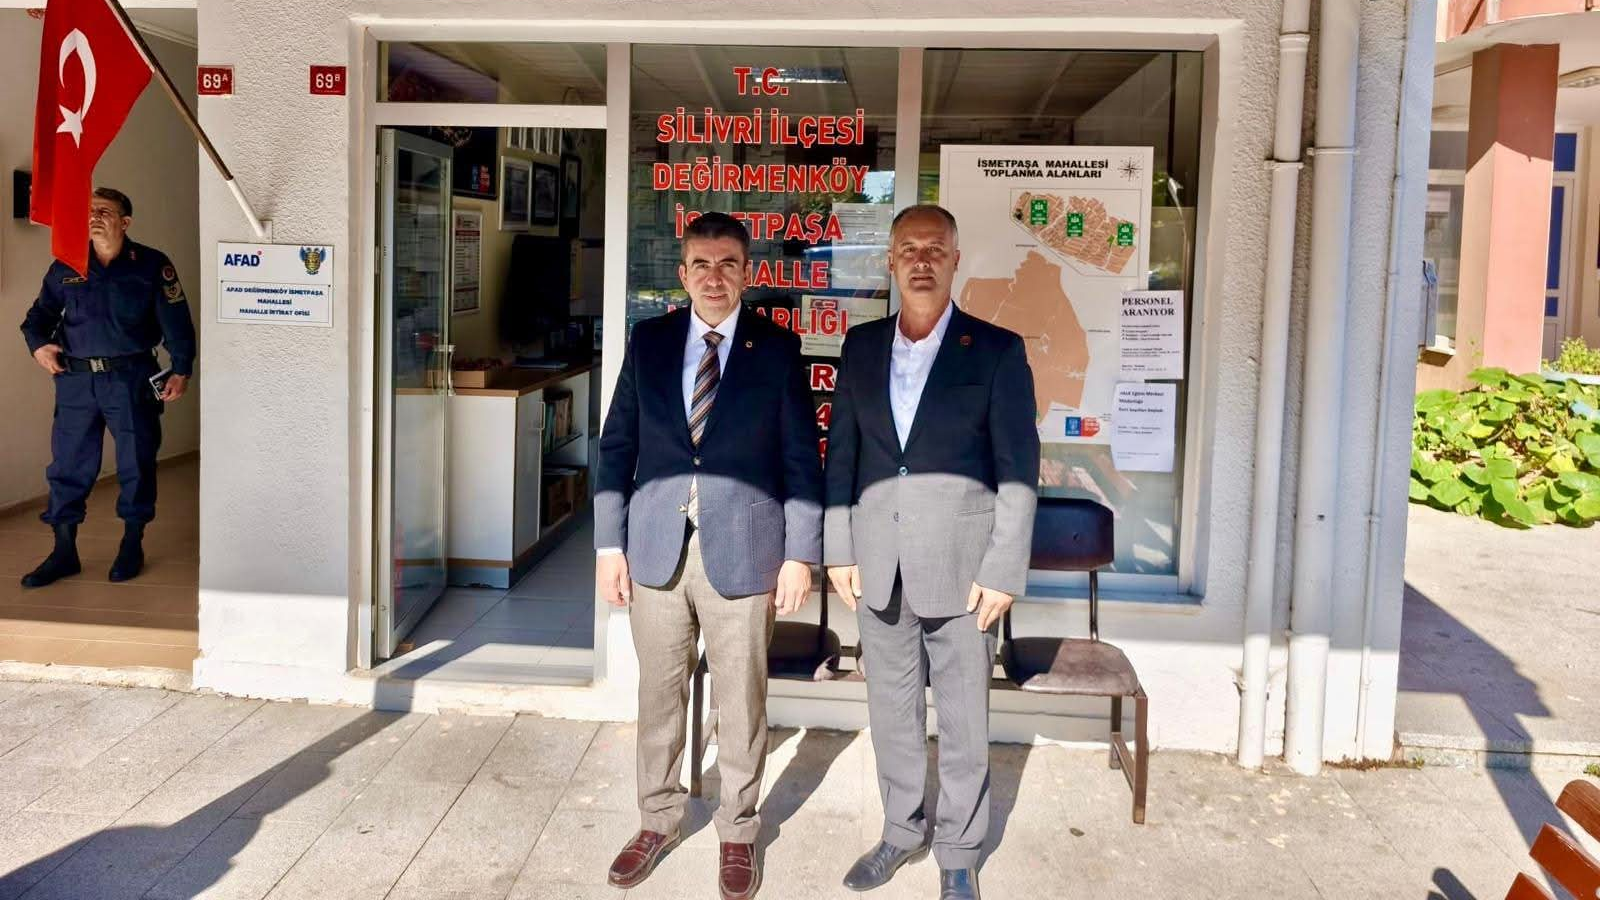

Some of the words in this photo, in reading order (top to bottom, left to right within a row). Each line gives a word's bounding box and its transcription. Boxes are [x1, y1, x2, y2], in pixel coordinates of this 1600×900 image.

[733, 67, 789, 96] T.C.
[656, 107, 762, 145] SİLİVRİ
[769, 107, 865, 149] İLÇESİ
[977, 157, 1039, 170] İSMETPAŞA
[1045, 158, 1109, 169] MAHALLESİ
[653, 155, 869, 194] DEĞİRMENKÖY
[983, 168, 1044, 178] TOPLANMA
[1046, 169, 1102, 179] ALANLARI
[223, 253, 260, 267] AFAD
[1121, 297, 1174, 306] PERSONEL
[1121, 308, 1175, 317] ARANIYOR
